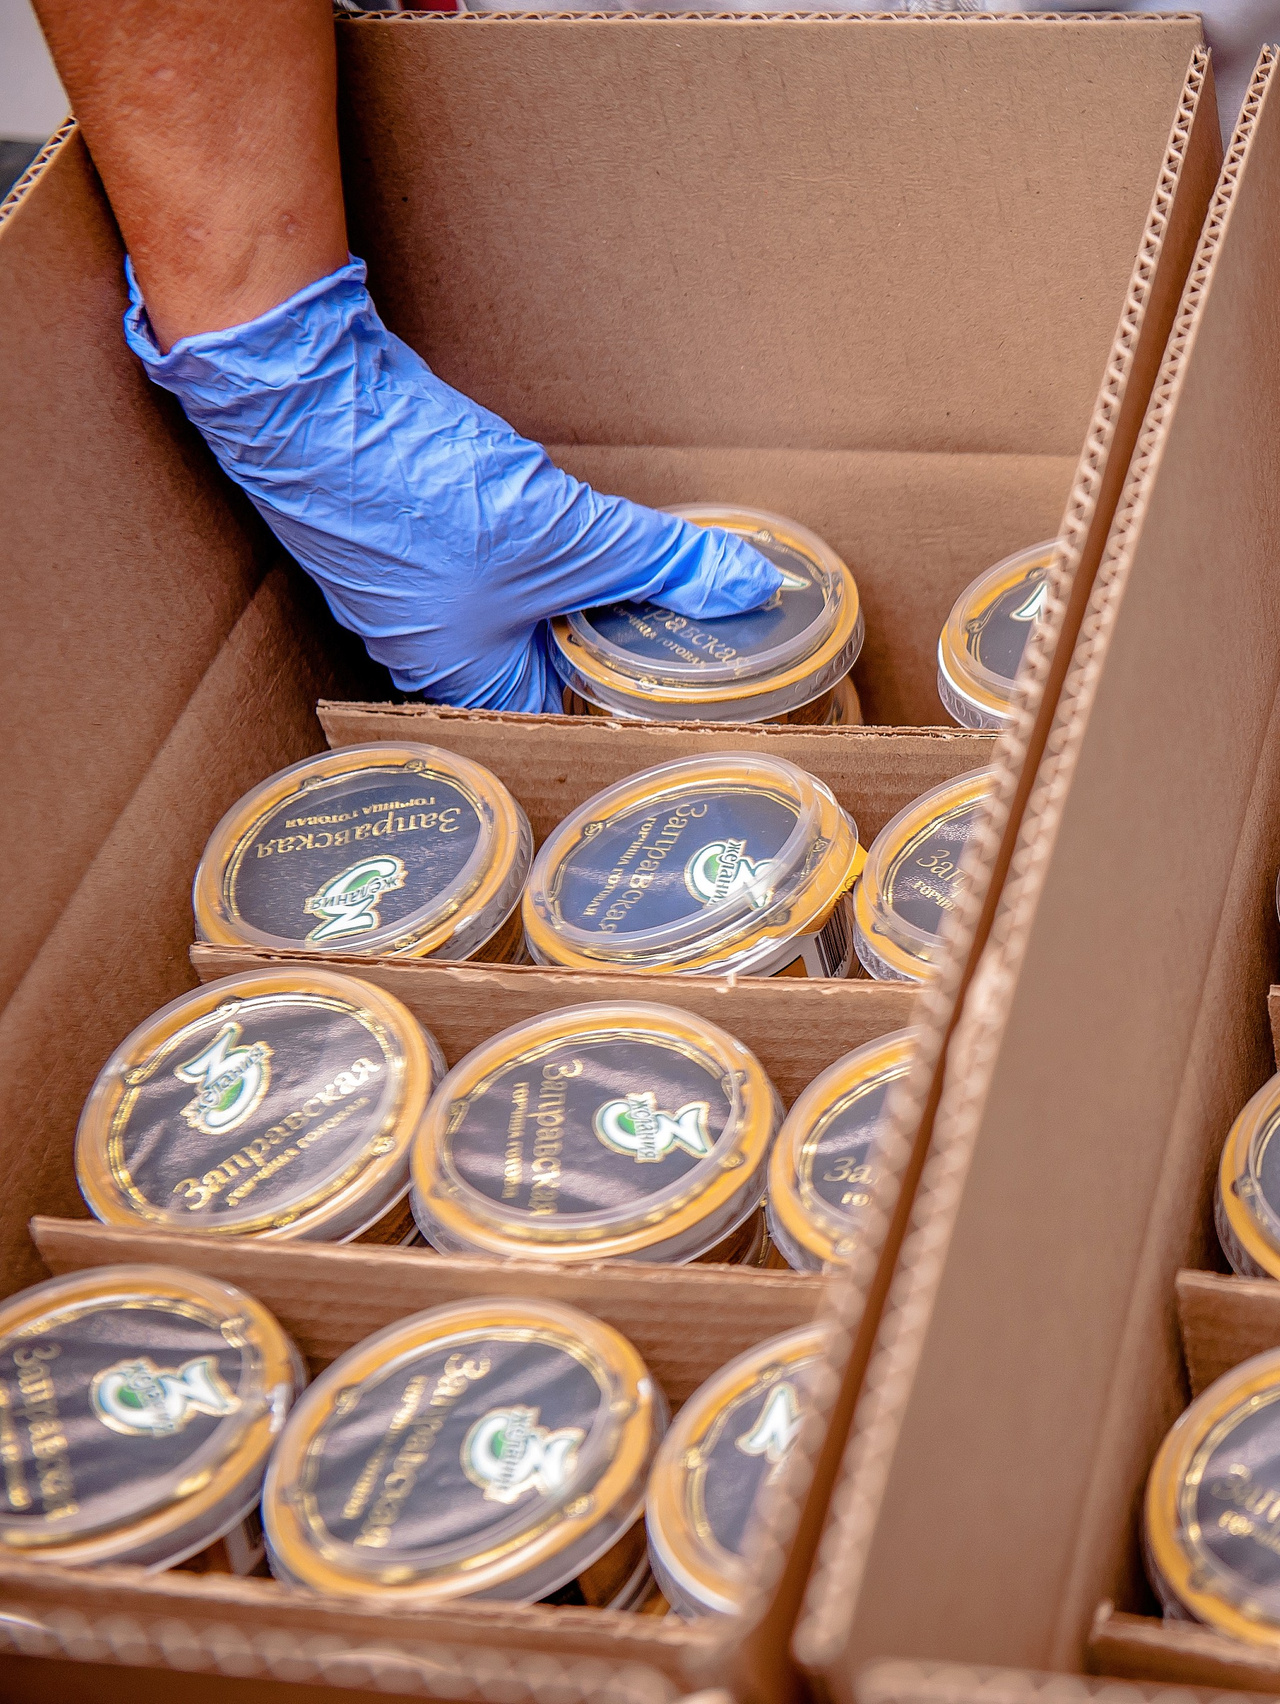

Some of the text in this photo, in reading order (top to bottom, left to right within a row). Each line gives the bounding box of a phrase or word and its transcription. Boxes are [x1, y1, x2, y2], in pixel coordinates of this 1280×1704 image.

[643, 608, 752, 677] равская
[255, 808, 463, 859] Заправская
[310, 876, 401, 912] желания
[598, 803, 708, 935] Заправская
[912, 880, 955, 912] ГОРЧИ
[173, 1057, 381, 1211] Заправская
